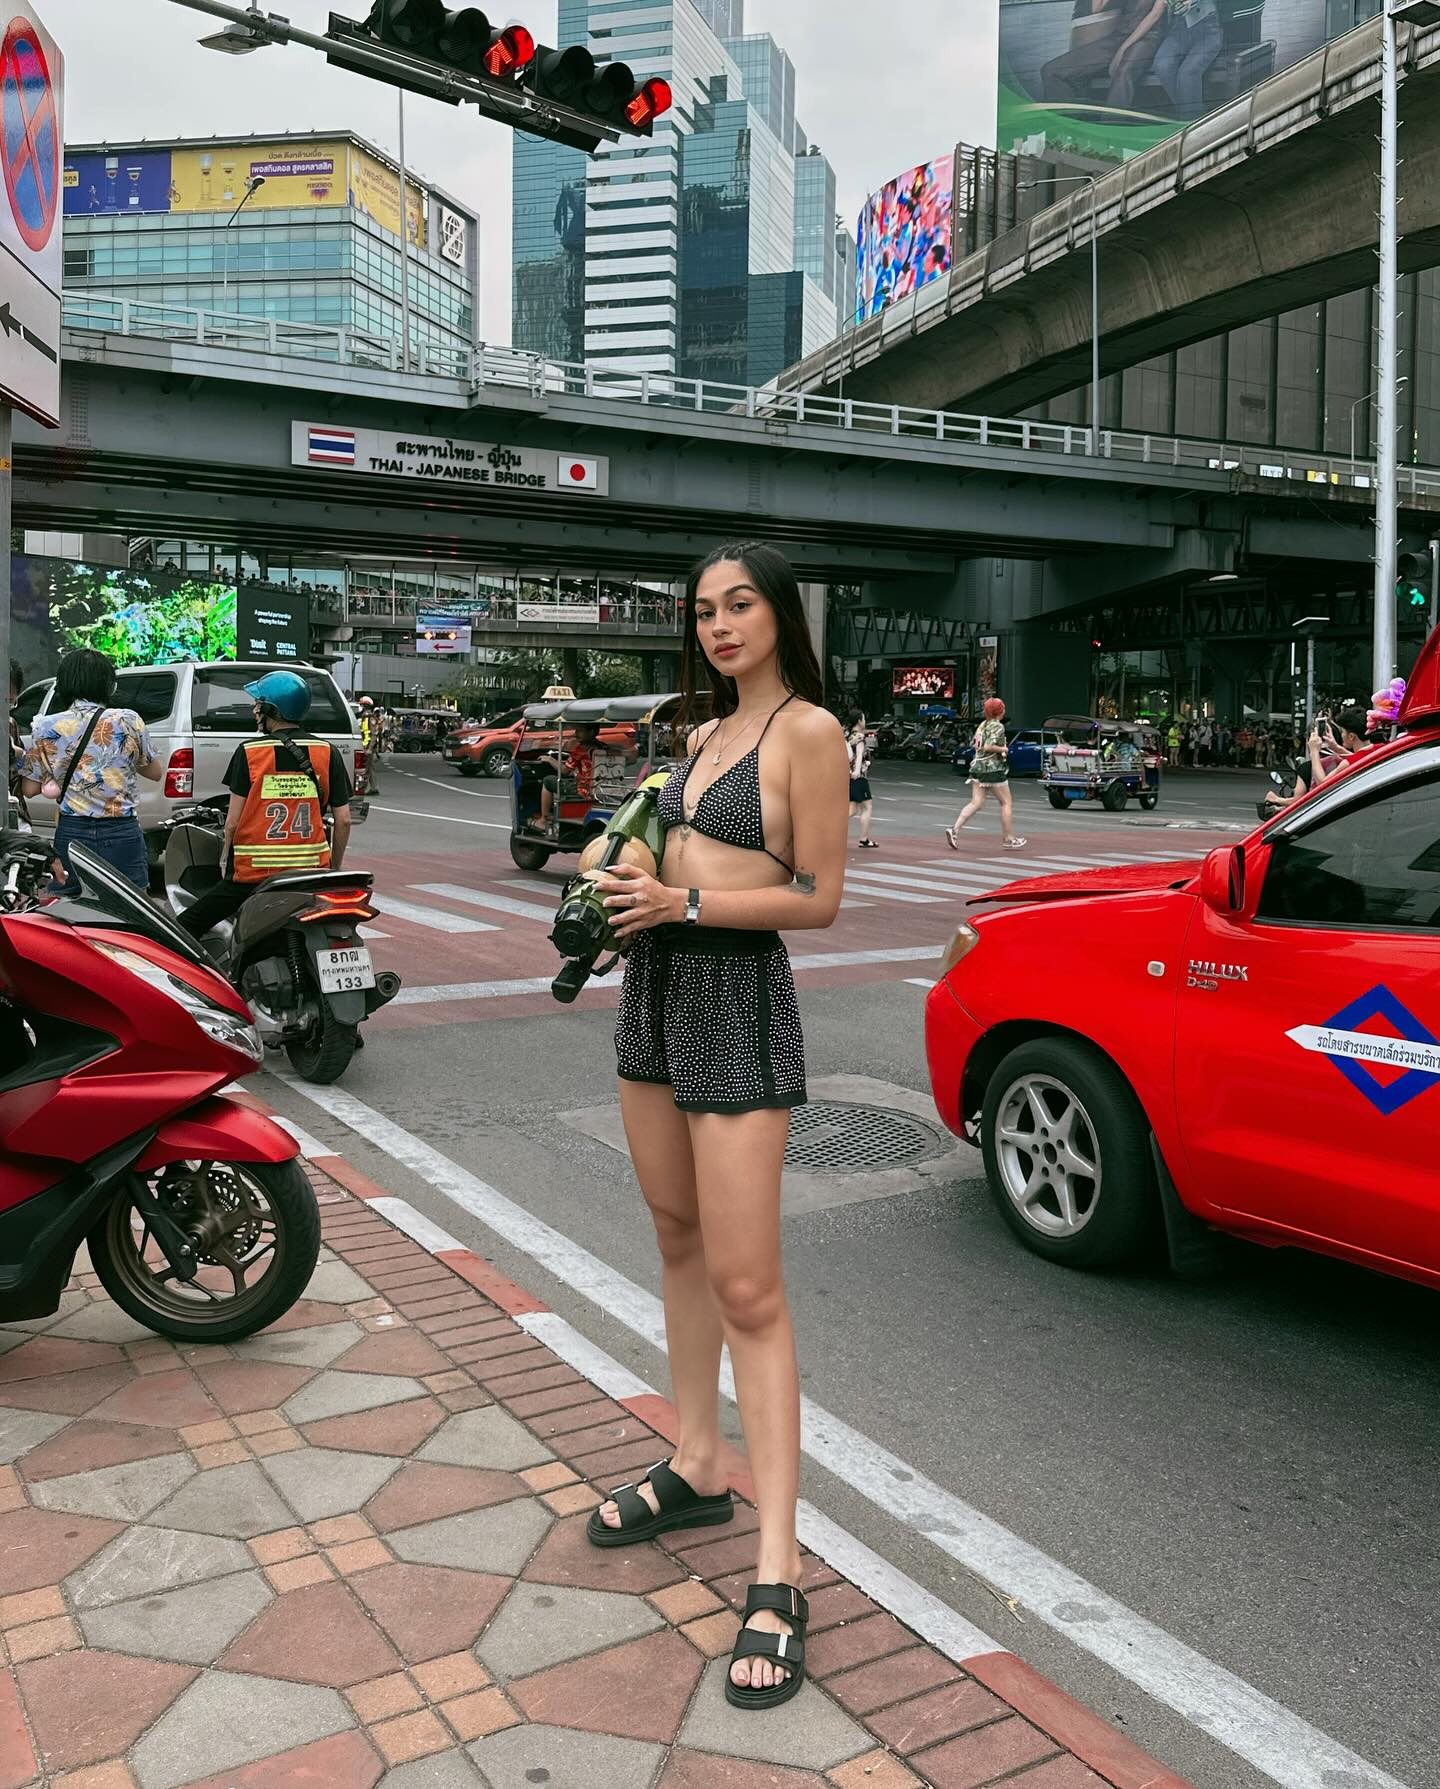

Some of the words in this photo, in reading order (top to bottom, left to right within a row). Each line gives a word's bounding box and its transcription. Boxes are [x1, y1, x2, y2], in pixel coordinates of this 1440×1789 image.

[396, 440, 474, 461] สะพานไทย
[369, 457, 403, 472] THAI
[416, 463, 489, 481] JAPANESE
[495, 470, 546, 487] BRIDGE
[551, 687, 570, 696] TAXI
[265, 802, 314, 840] 24
[1188, 960, 1248, 981] HILUX
[336, 977, 362, 990] 133
